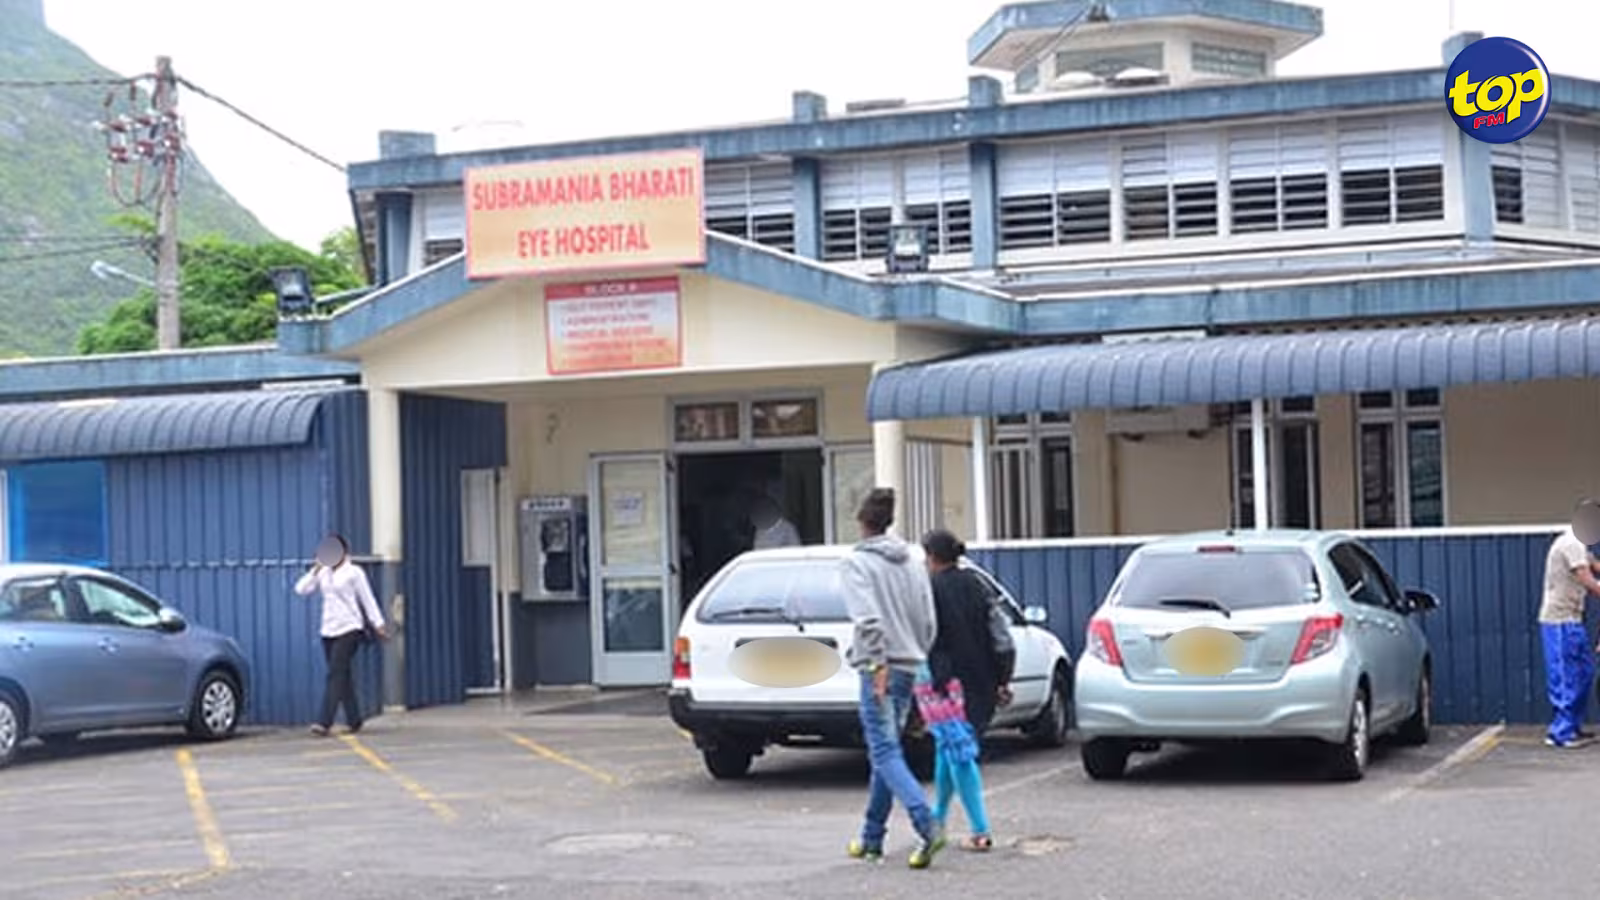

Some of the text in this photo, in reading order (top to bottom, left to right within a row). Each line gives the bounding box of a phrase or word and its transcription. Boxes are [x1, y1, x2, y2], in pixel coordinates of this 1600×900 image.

[473, 167, 694, 211] SUBRAMANIA BHARATI
[518, 223, 649, 258] EYE HOSPITAL
